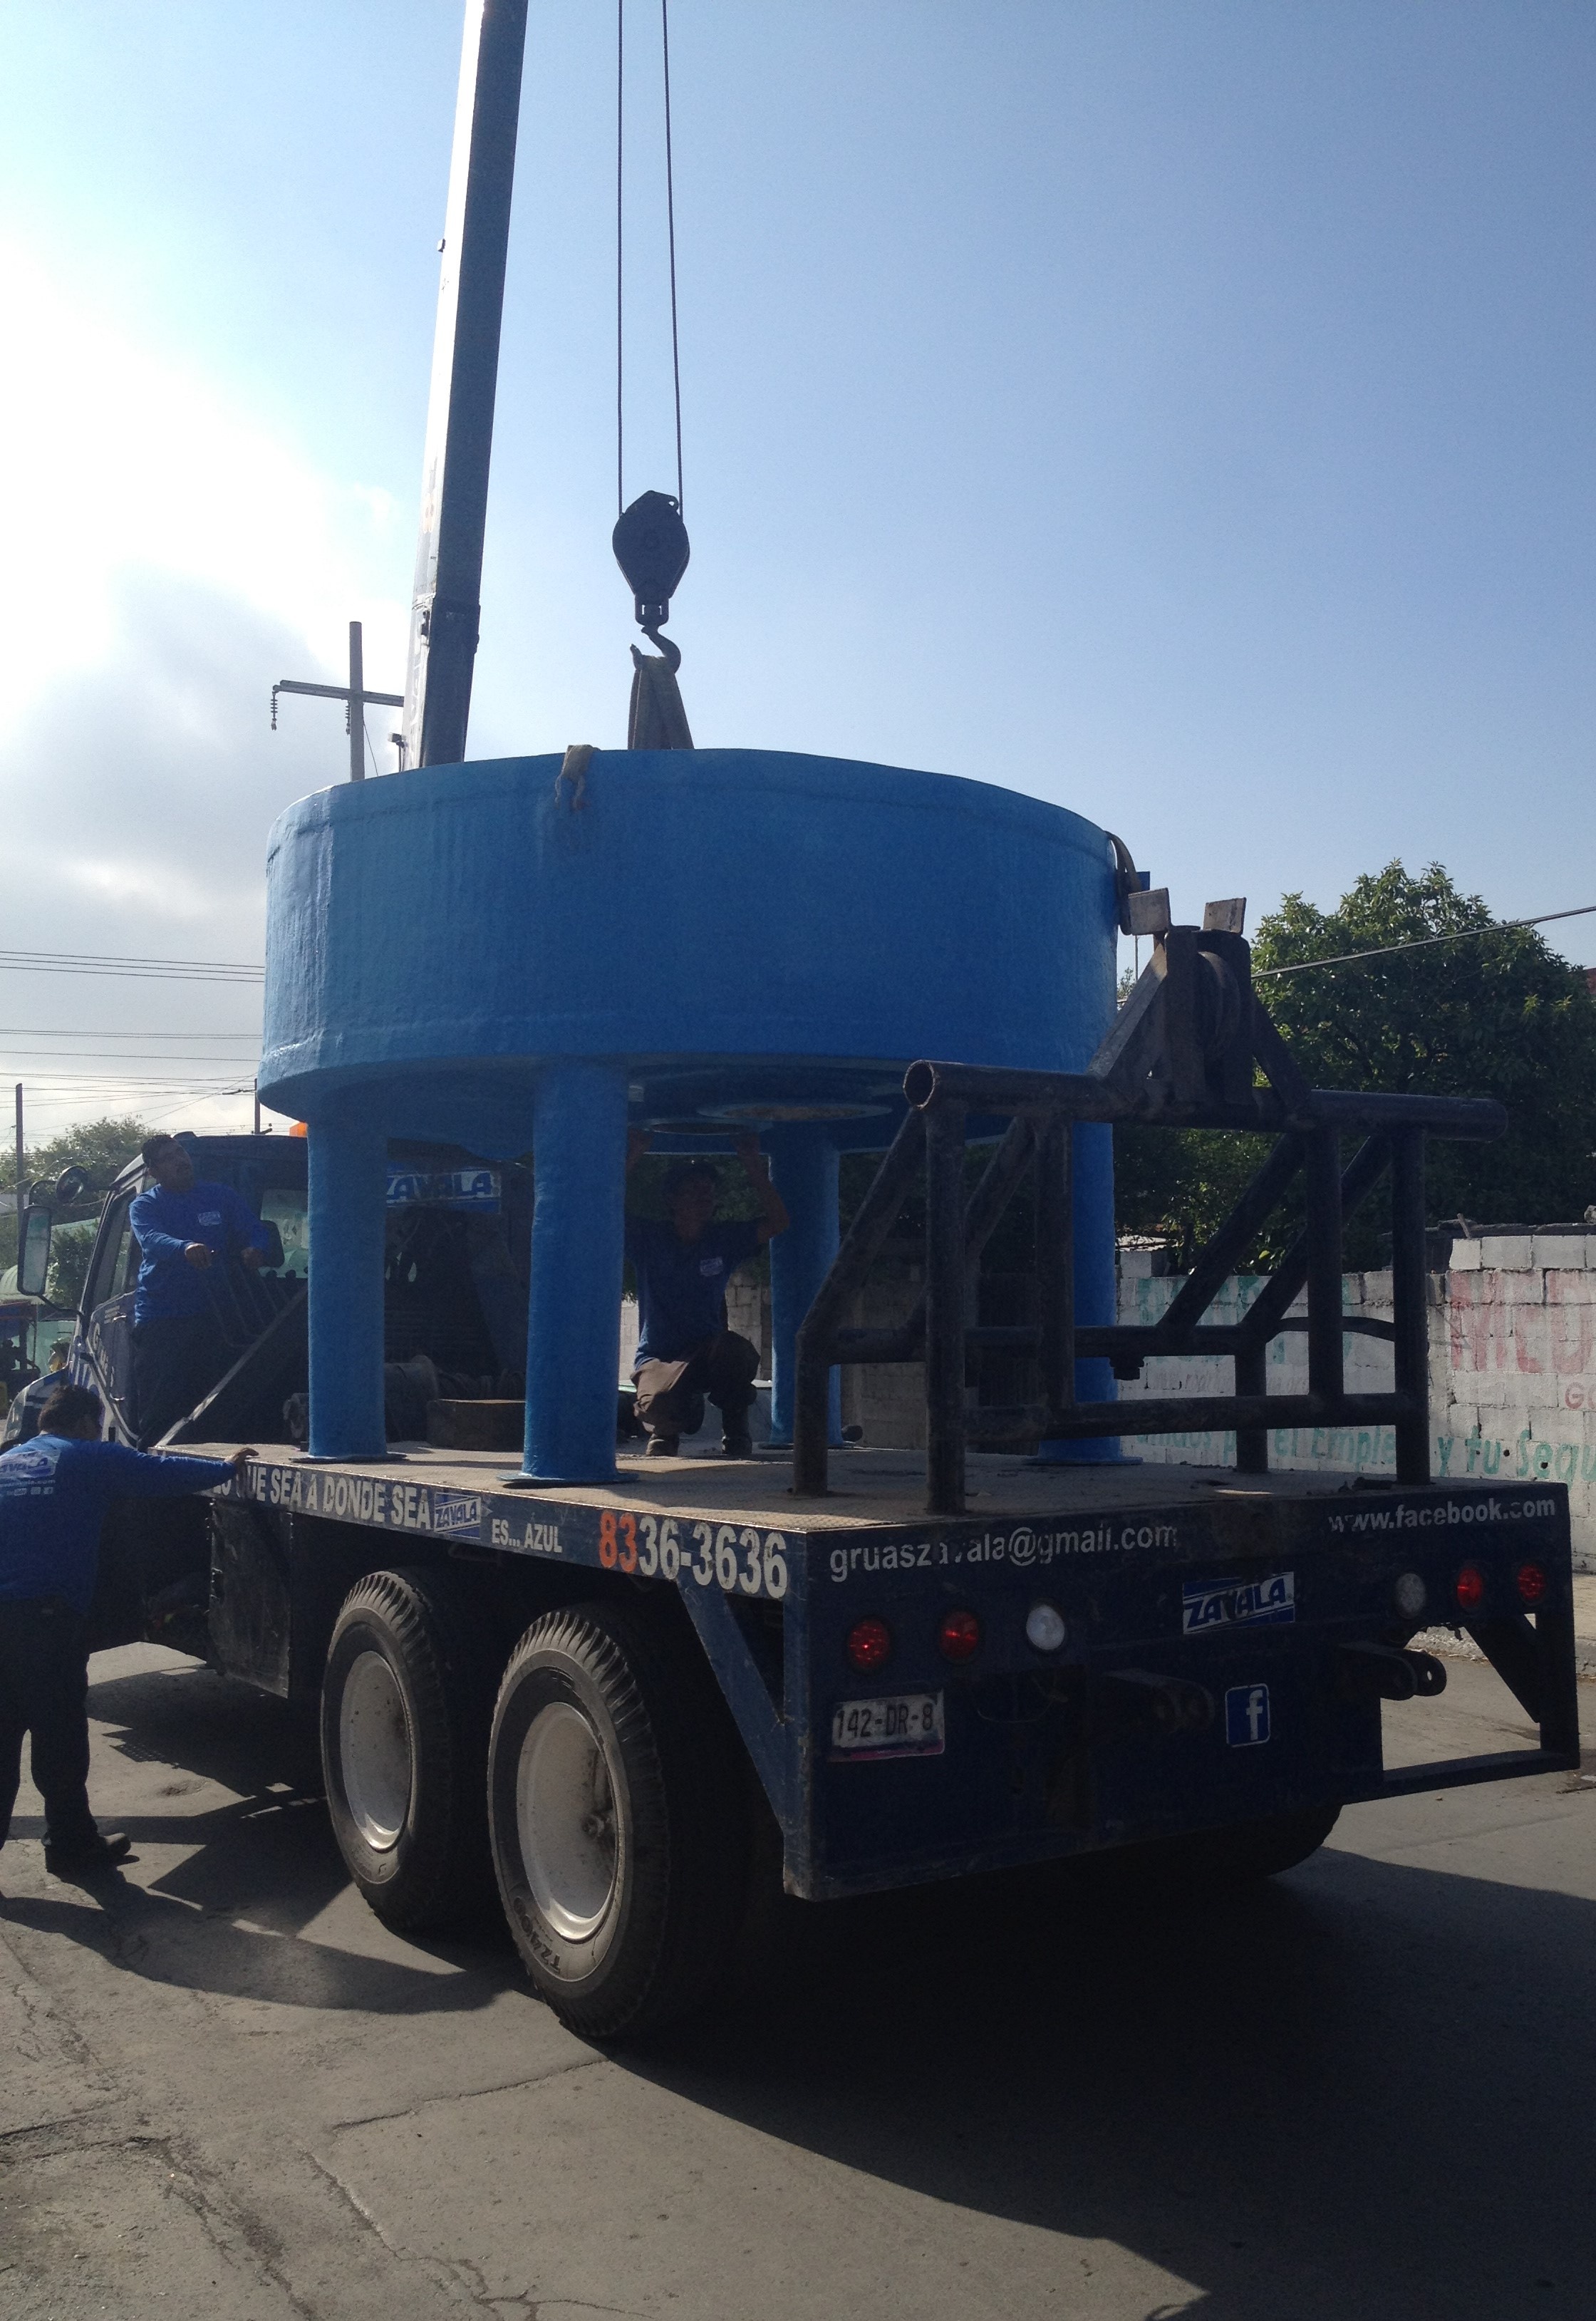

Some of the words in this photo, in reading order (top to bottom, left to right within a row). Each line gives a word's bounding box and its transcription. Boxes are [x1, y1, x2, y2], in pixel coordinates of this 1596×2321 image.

[1465, 1425, 1501, 1474] tu
[270, 1468, 302, 1507] SEA
[306, 1473, 318, 1511] A
[323, 1475, 386, 1523] DONDE
[391, 1484, 431, 1530] SEA
[435, 1501, 477, 1528] ZAVALA
[492, 1519, 520, 1547] ES...
[524, 1522, 562, 1553] AZUL
[1329, 1498, 1555, 1532] www.facebook.com
[1183, 1578, 1286, 1628] ZAVALA
[837, 1702, 933, 1740] 142-DR-8
